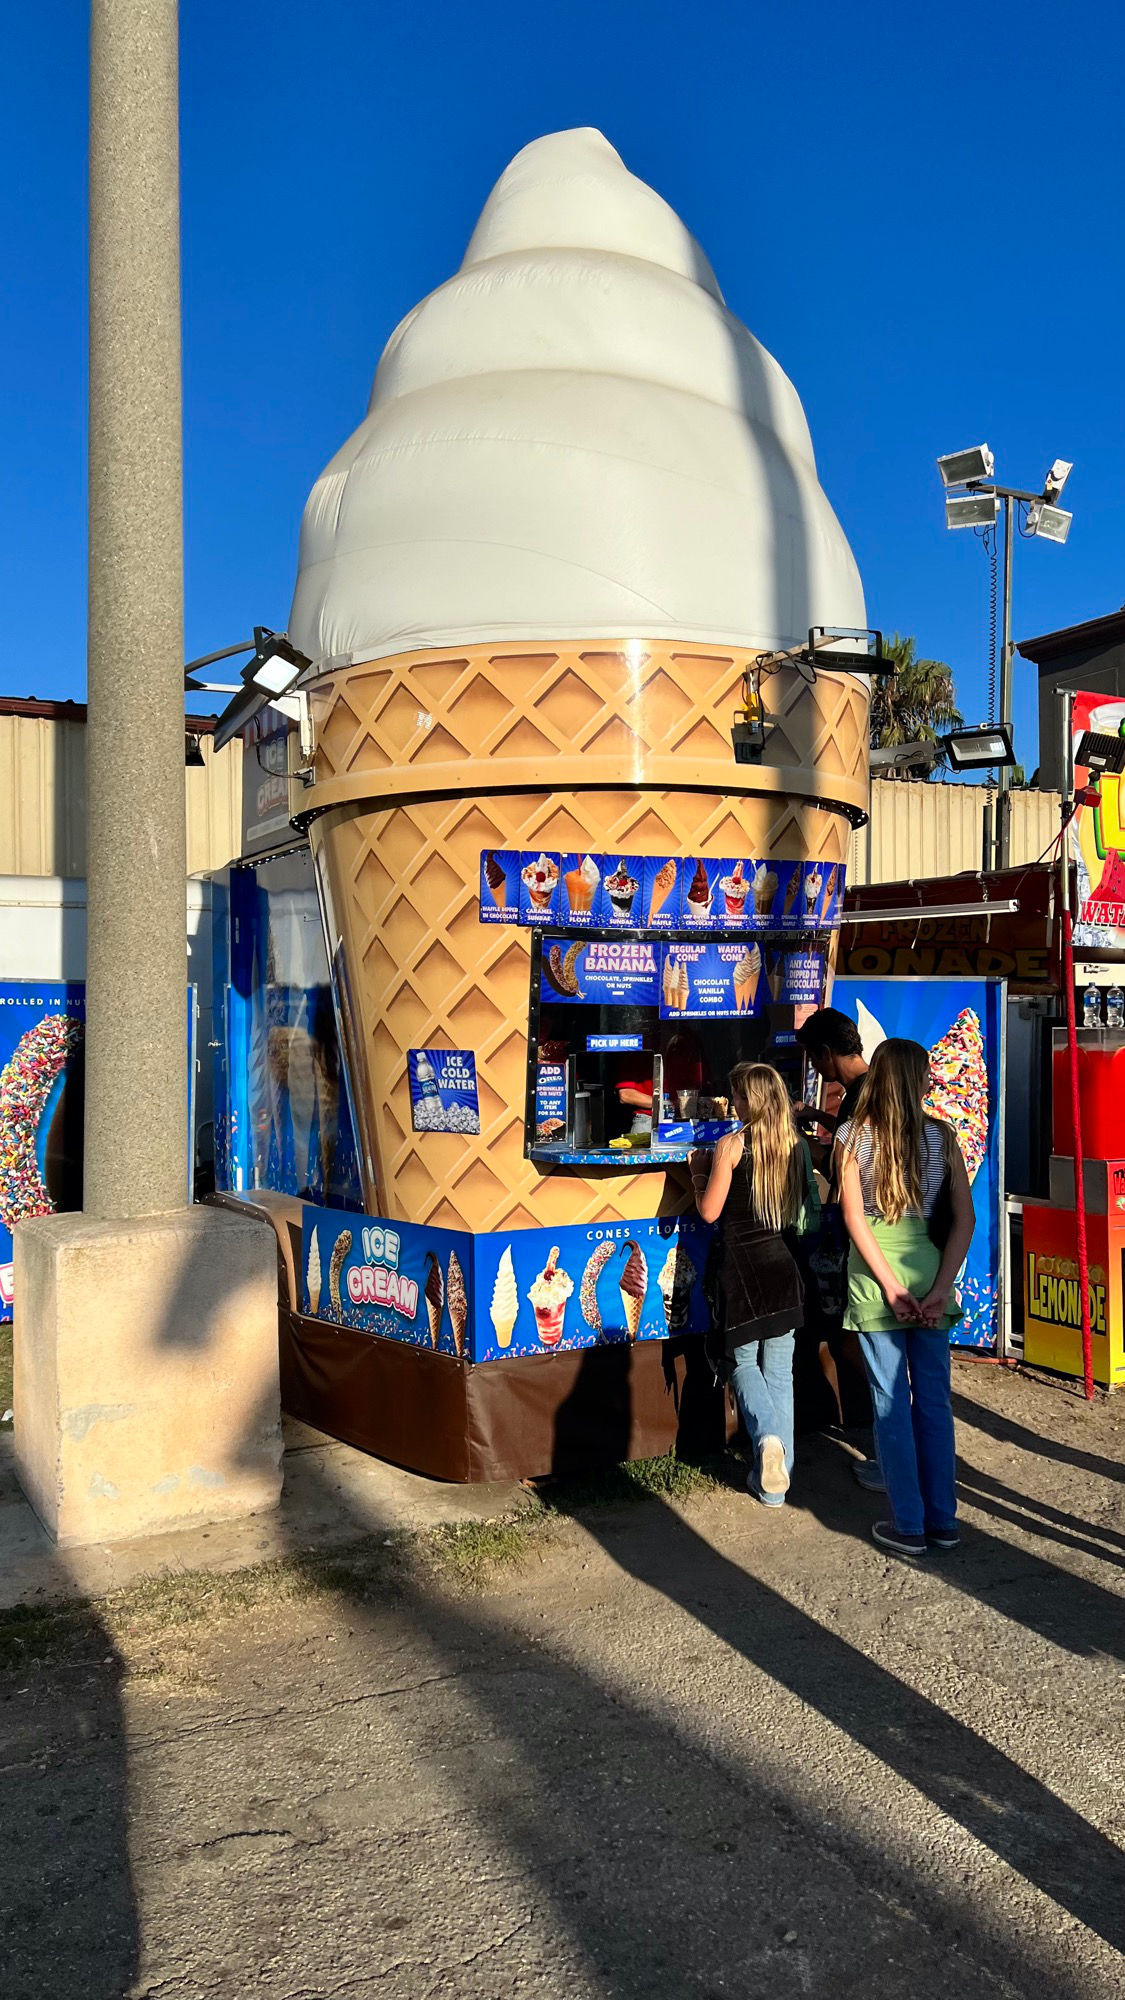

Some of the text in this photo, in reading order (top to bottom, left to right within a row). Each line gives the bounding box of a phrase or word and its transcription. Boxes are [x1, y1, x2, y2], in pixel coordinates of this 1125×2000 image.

[257, 774, 288, 816] CREA
[1081, 900, 1125, 927] WAT
[880, 915, 993, 943] FROZEN
[590, 944, 653, 958] FROZEN
[669, 945, 747, 954] REGULAR WAFFLE
[677, 953, 743, 962] CONE CONE
[841, 947, 1050, 978] ONADE
[585, 958, 657, 972] BANANA
[789, 960, 820, 969] ANY CONE
[790, 970, 818, 979] DIPPED IN
[786, 979, 820, 989] CHOCOLATE
[0, 998, 44, 1006] ROLLED
[590, 1039, 639, 1047] PICK UP HERE
[446, 1057, 463, 1067] ICE
[441, 1068, 470, 1078] COLD
[540, 1067, 561, 1075] ADD
[438, 1079, 475, 1090] WATER
[538, 1075, 562, 1084] OREO
[586, 1223, 696, 1240] CONES FLOATS
[362, 1227, 400, 1270] ICE
[347, 1266, 418, 1320] CREAM
